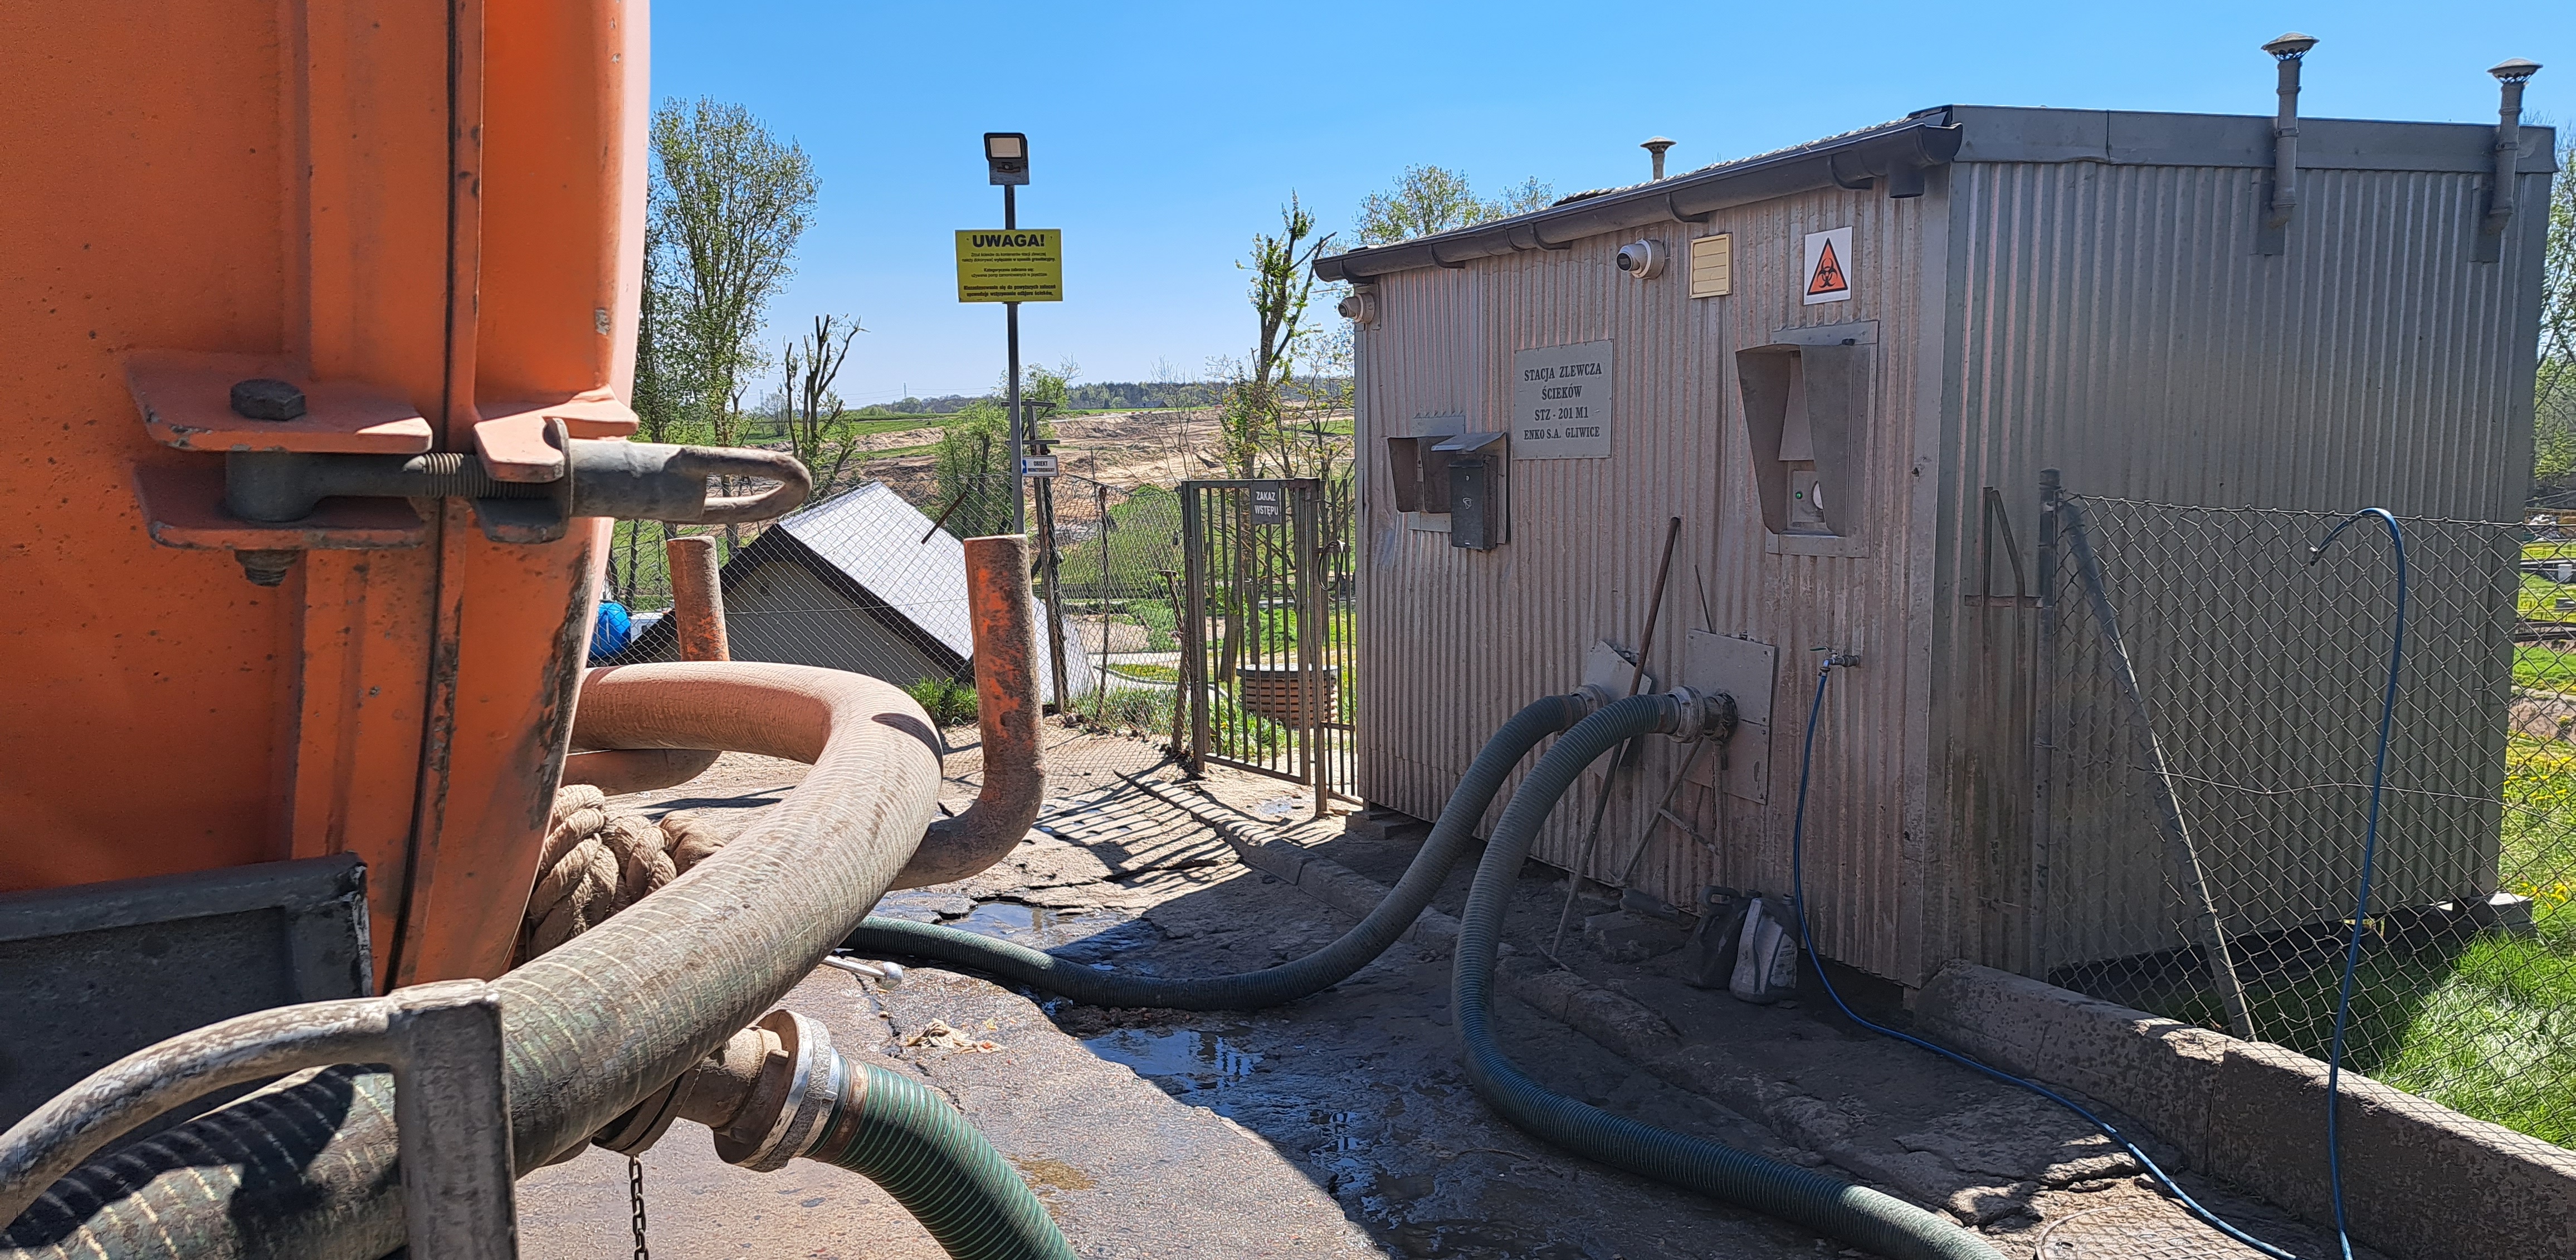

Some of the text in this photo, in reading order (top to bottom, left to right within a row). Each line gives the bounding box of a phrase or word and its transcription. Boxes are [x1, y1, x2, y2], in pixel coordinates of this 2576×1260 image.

[972, 234, 1045, 247] UWAGA!
[1524, 363, 1602, 382] STACJA ZLEWCZA
[1541, 383, 1582, 400] ŚCIEKÓW
[1534, 409, 1551, 421] STZ
[1558, 407, 1573, 419] 201
[1575, 406, 1589, 418] M1
[1524, 429, 1545, 440] ENKO
[1565, 426, 1600, 438] GLIWICE
[1256, 491, 1276, 501] ZAKAZ
[1254, 505, 1279, 517] WSTĘPU
